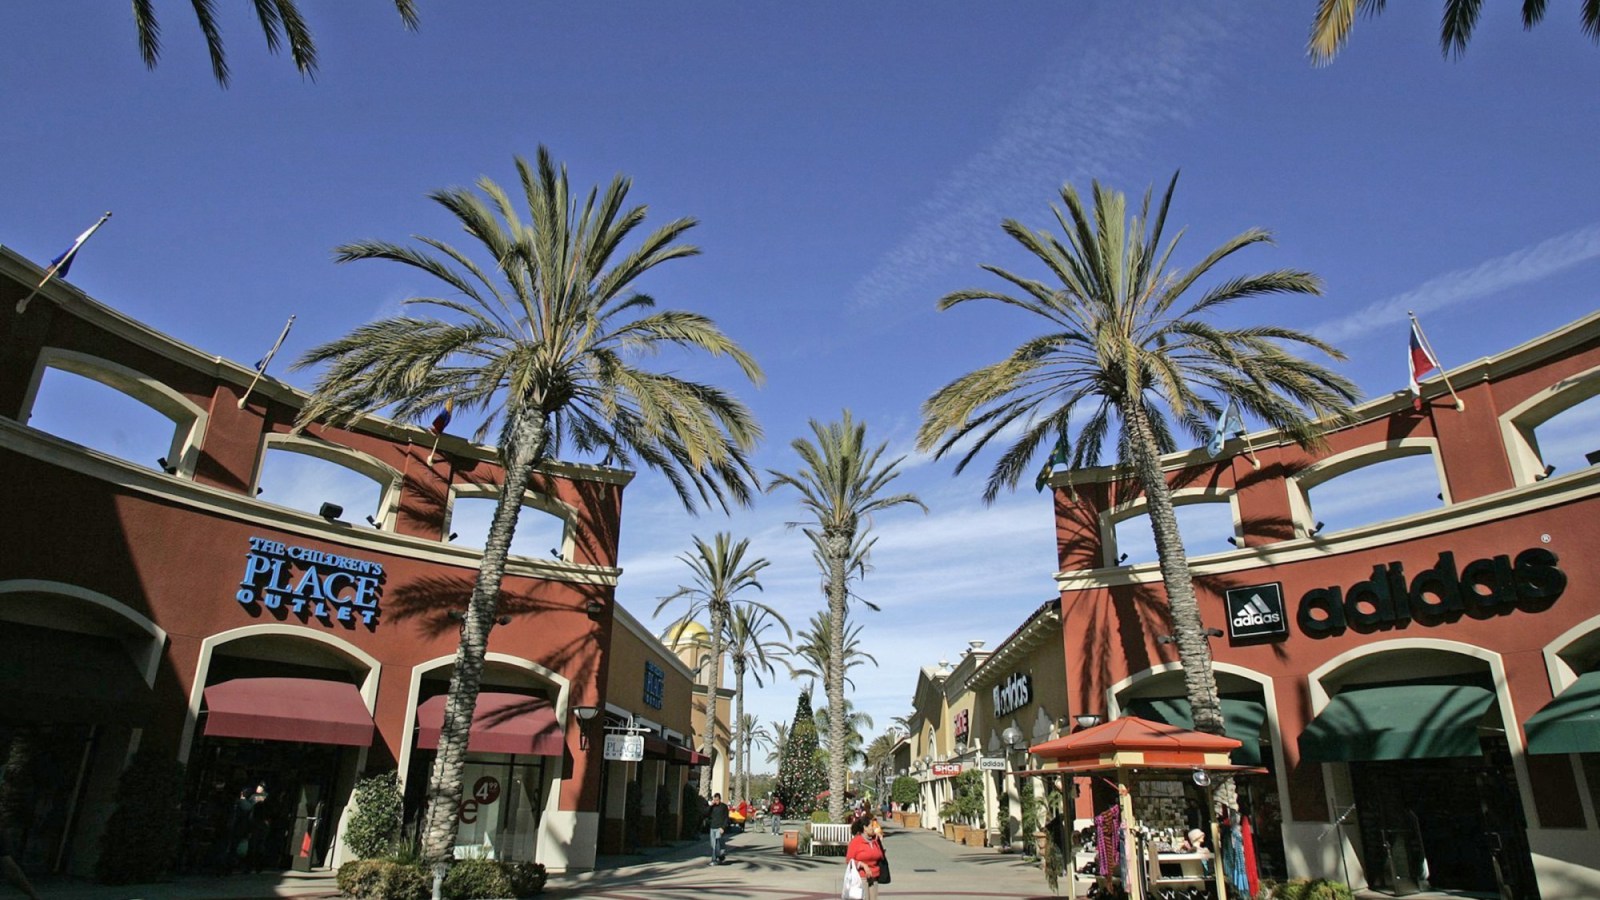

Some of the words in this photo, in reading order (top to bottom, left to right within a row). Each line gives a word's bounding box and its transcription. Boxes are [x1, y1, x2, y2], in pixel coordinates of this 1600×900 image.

[249, 536, 285, 555] THE
[287, 546, 383, 575] CHILDREN'S
[239, 553, 379, 608] PLACE
[1297, 547, 1567, 640] adidas
[236, 588, 375, 624] OUTLET
[1233, 612, 1280, 627] adidas
[606, 741, 642, 754] PLACE
[982, 760, 1005, 768] adidas
